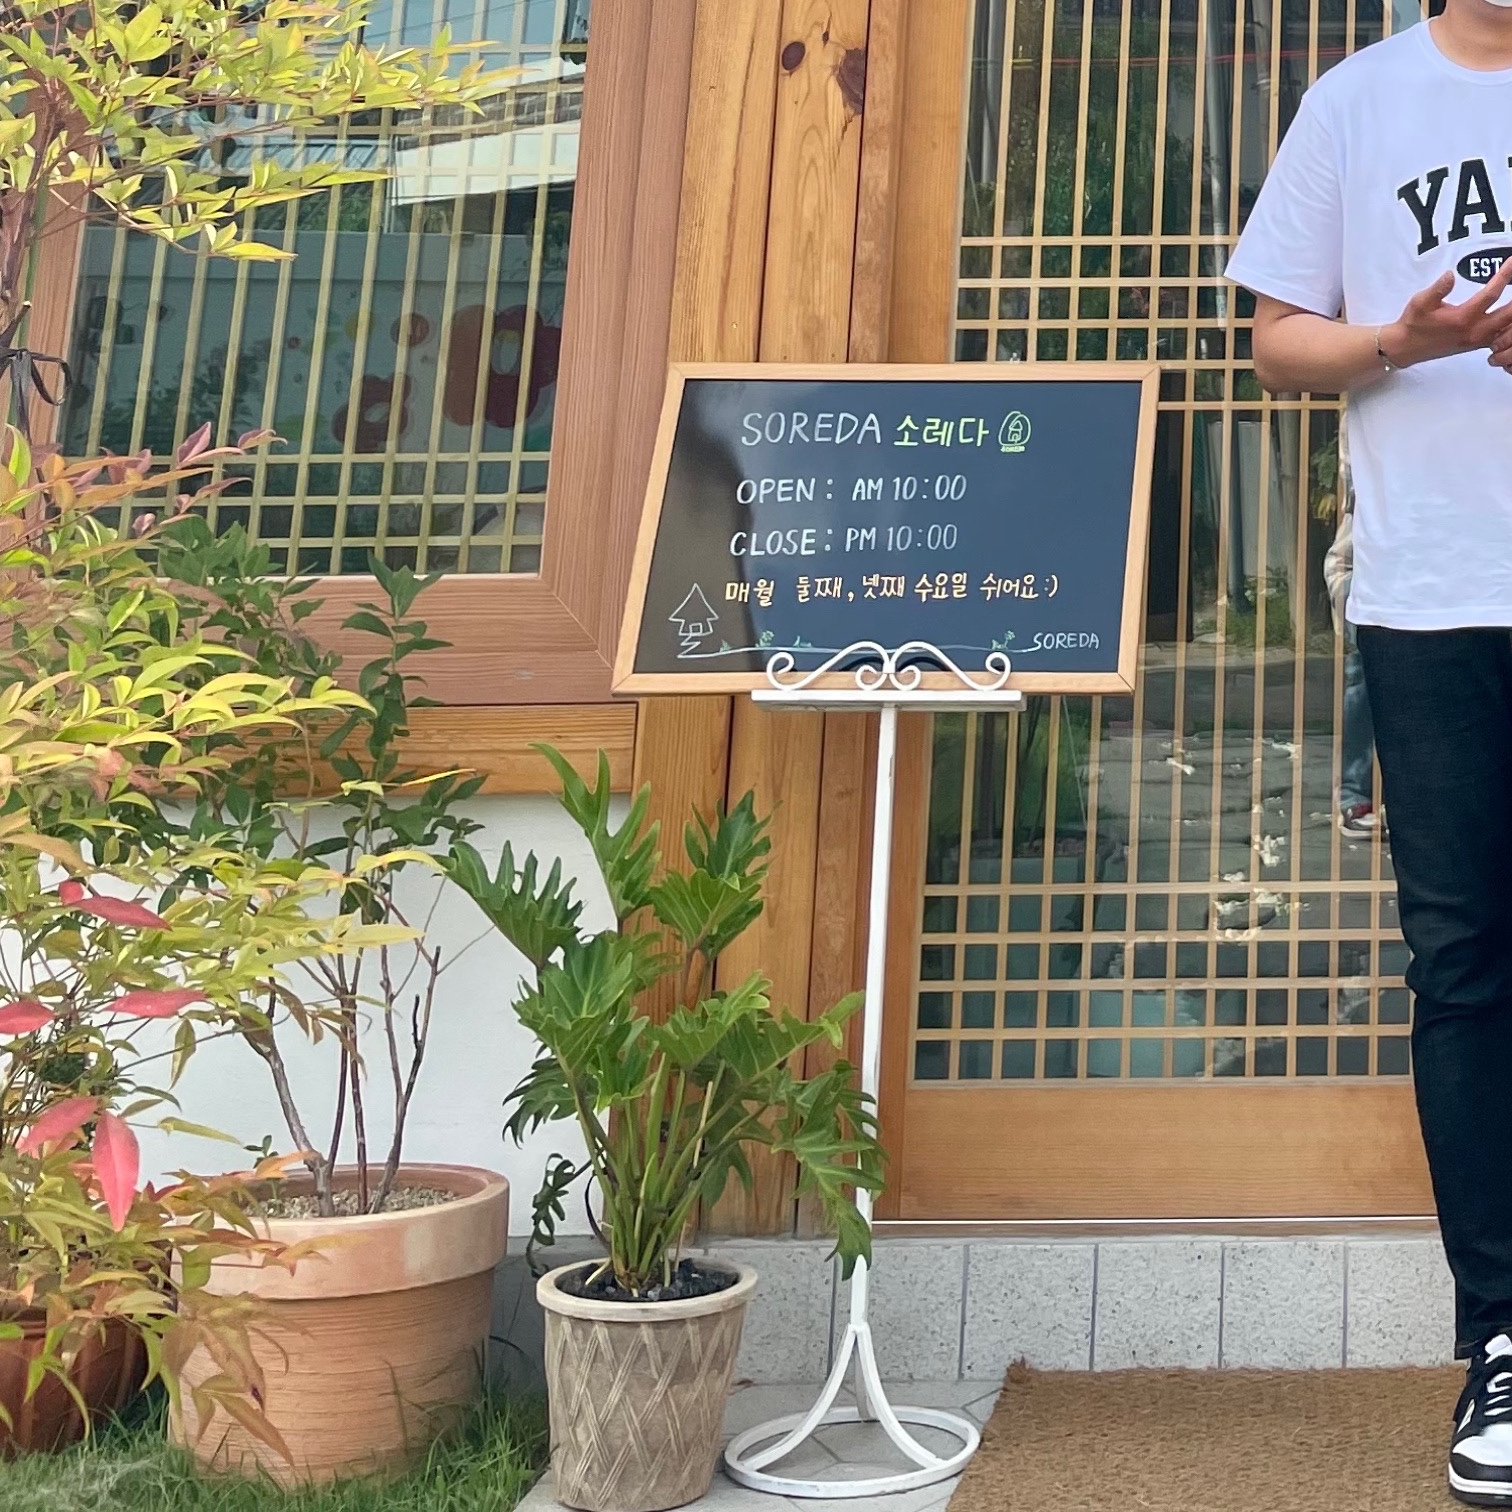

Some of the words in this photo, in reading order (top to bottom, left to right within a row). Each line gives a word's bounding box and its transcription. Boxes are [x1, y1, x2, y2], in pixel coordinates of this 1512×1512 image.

[1470, 257, 1503, 277] EST
[741, 411, 882, 447] SOREDA
[893, 414, 990, 448] 소레다
[851, 477, 884, 501] AM
[893, 474, 967, 501] 10:00
[845, 526, 877, 553] PM
[887, 523, 958, 552] 10:00
[725, 578, 775, 608] 매월
[914, 572, 968, 604] 수요일
[1032, 630, 1100, 651] SOREDA
